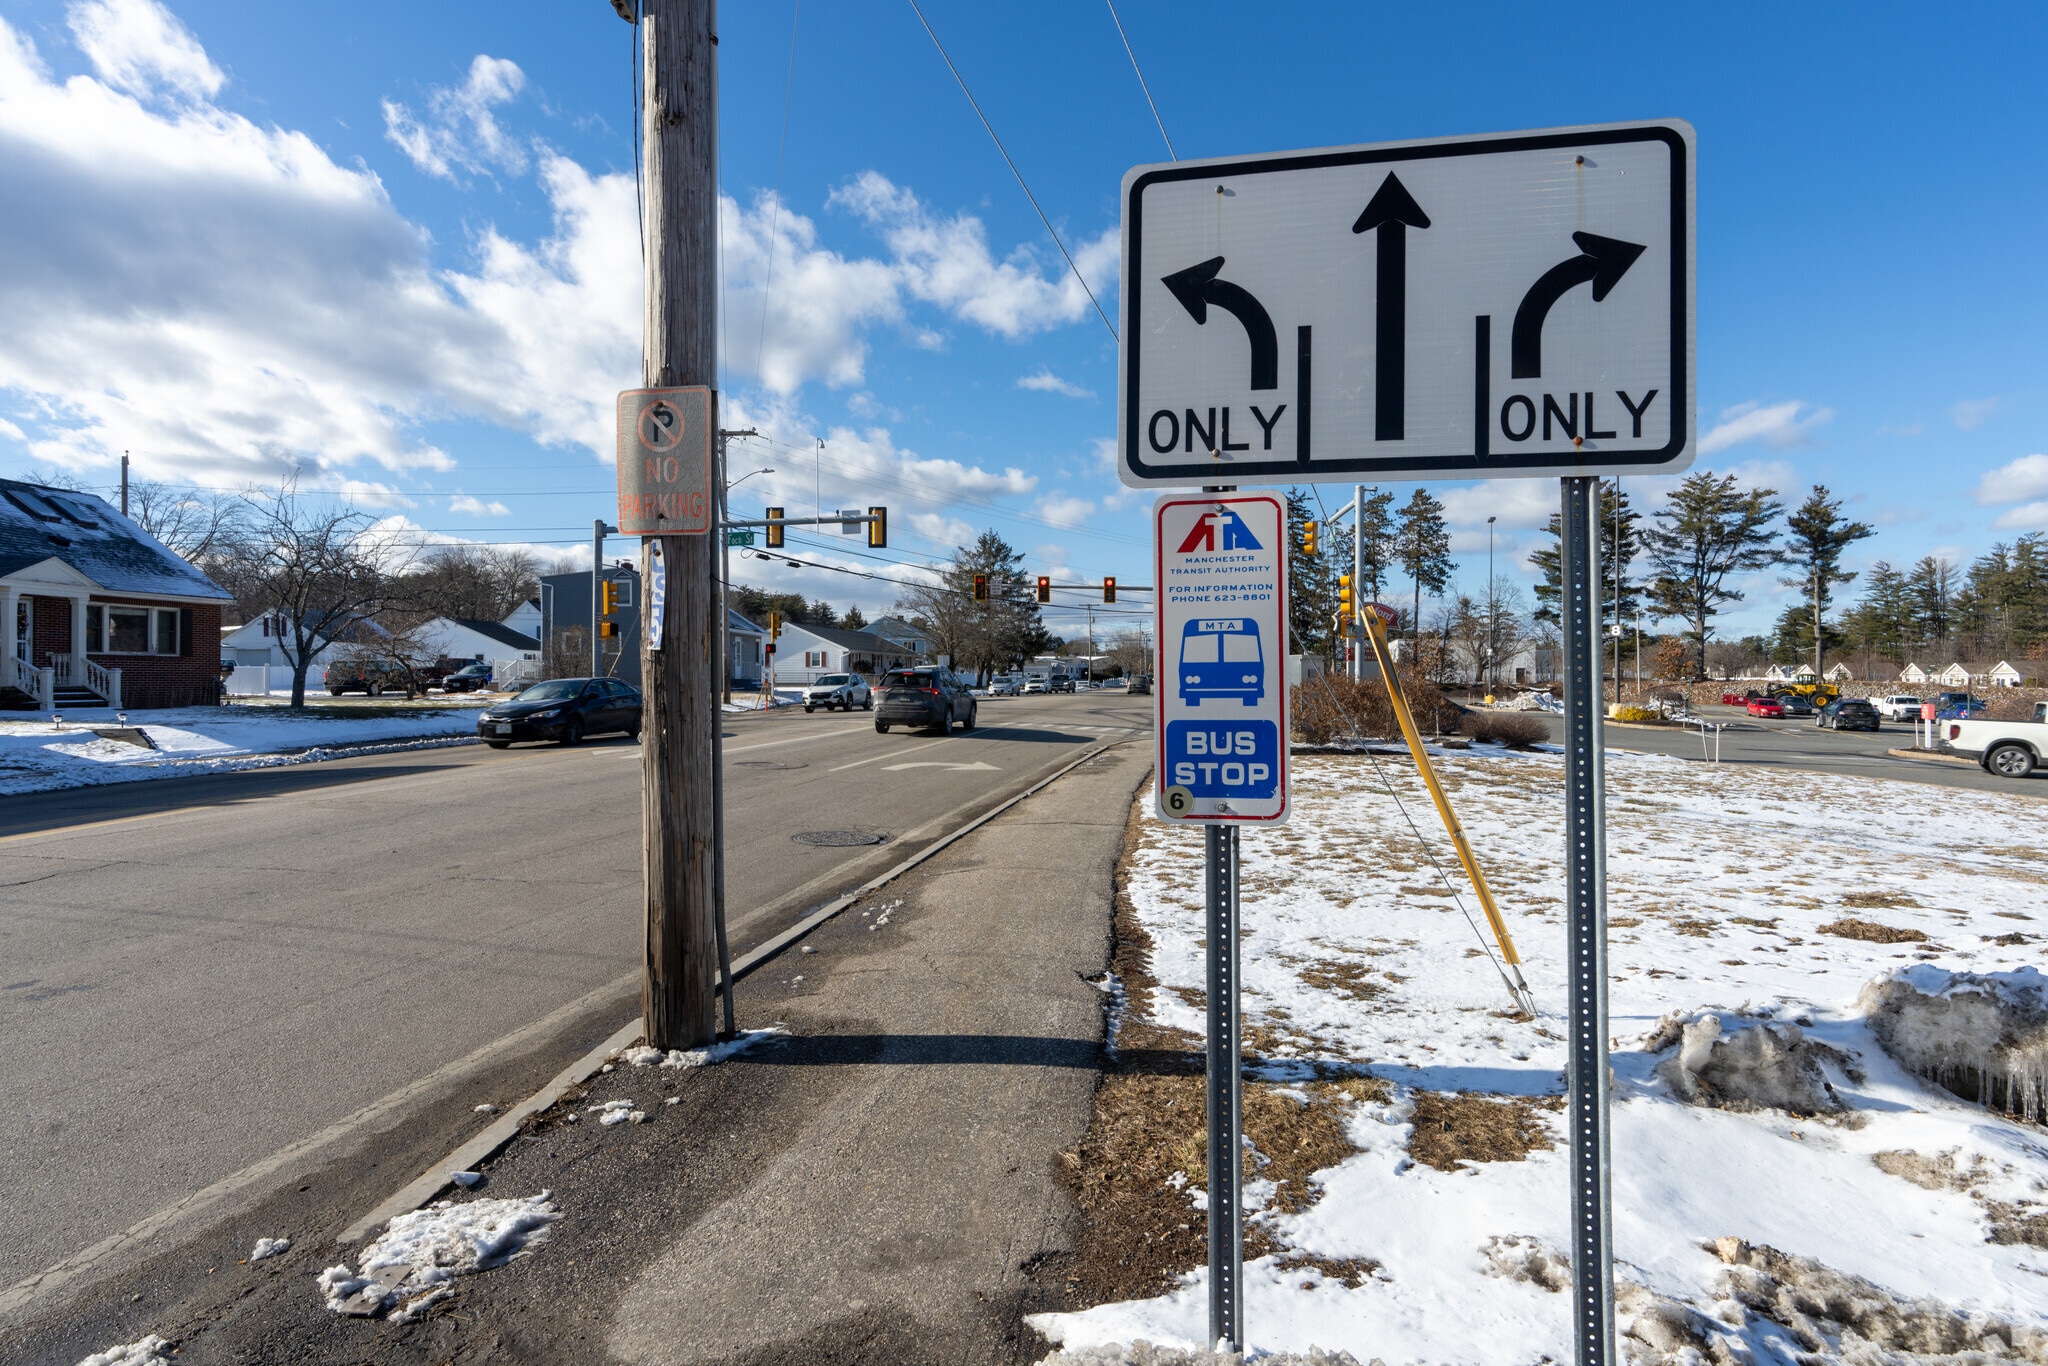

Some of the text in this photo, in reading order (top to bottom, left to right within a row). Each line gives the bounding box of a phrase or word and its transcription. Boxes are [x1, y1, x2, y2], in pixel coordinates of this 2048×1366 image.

[1500, 389, 1659, 443] ONLY
[1148, 404, 1288, 454] ONLY
[645, 457, 679, 484] NO
[623, 491, 704, 520] PARKING
[745, 533, 753, 544] St
[1185, 555, 1255, 564] MANCHESTER
[1170, 566, 1271, 575] TRANSIT AUTHORITY
[1169, 583, 1274, 593] FOR INFORMATION
[1171, 593, 1271, 603] PHONE 623-8801
[1205, 621, 1236, 630] MTA
[1611, 625, 1621, 636] 8
[1186, 731, 1256, 755] BUS
[1175, 762, 1269, 786] STOP
[1169, 792, 1184, 810] 6
